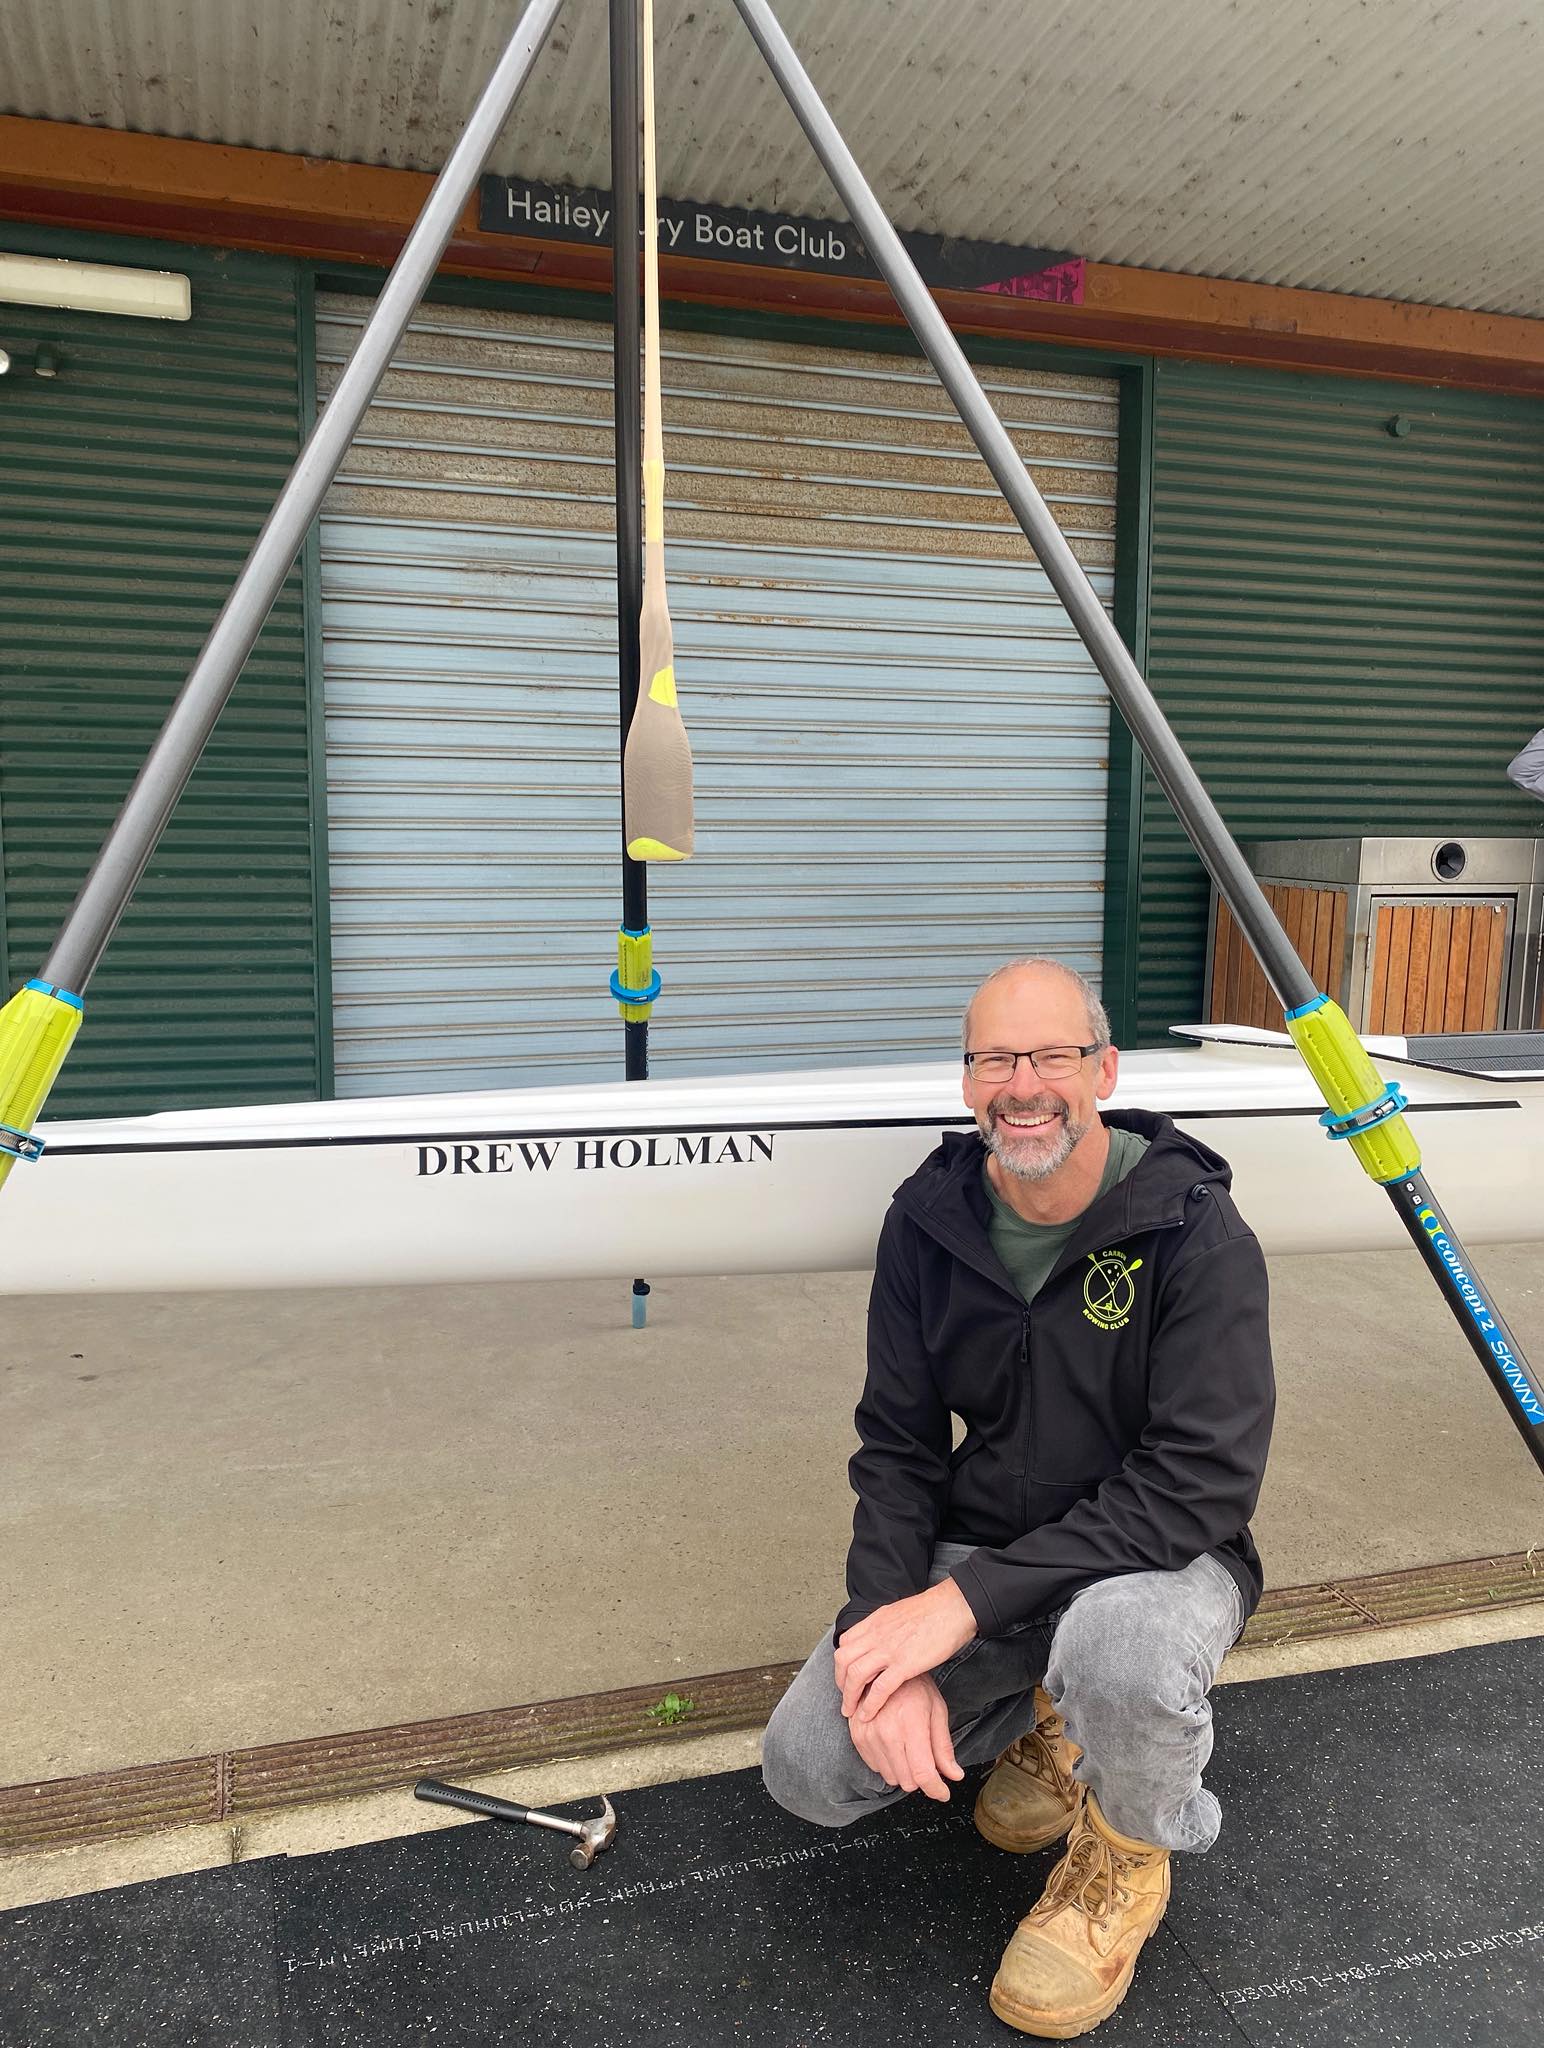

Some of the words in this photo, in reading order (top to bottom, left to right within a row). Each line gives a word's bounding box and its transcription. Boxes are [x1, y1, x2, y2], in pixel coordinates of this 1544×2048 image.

[506, 187, 685, 247] Haileyry
[694, 214, 764, 251] Boat
[774, 224, 847, 261] Club
[415, 1140, 562, 1177] DREW
[573, 1133, 777, 1170] HOLMAN
[1082, 1308, 1109, 1330] ROWING
[1110, 1317, 1130, 1330] CLUB
[1436, 1238, 1488, 1316] concept
[1480, 1320, 1495, 1332] 2
[1490, 1340, 1544, 1417] SKINNY
